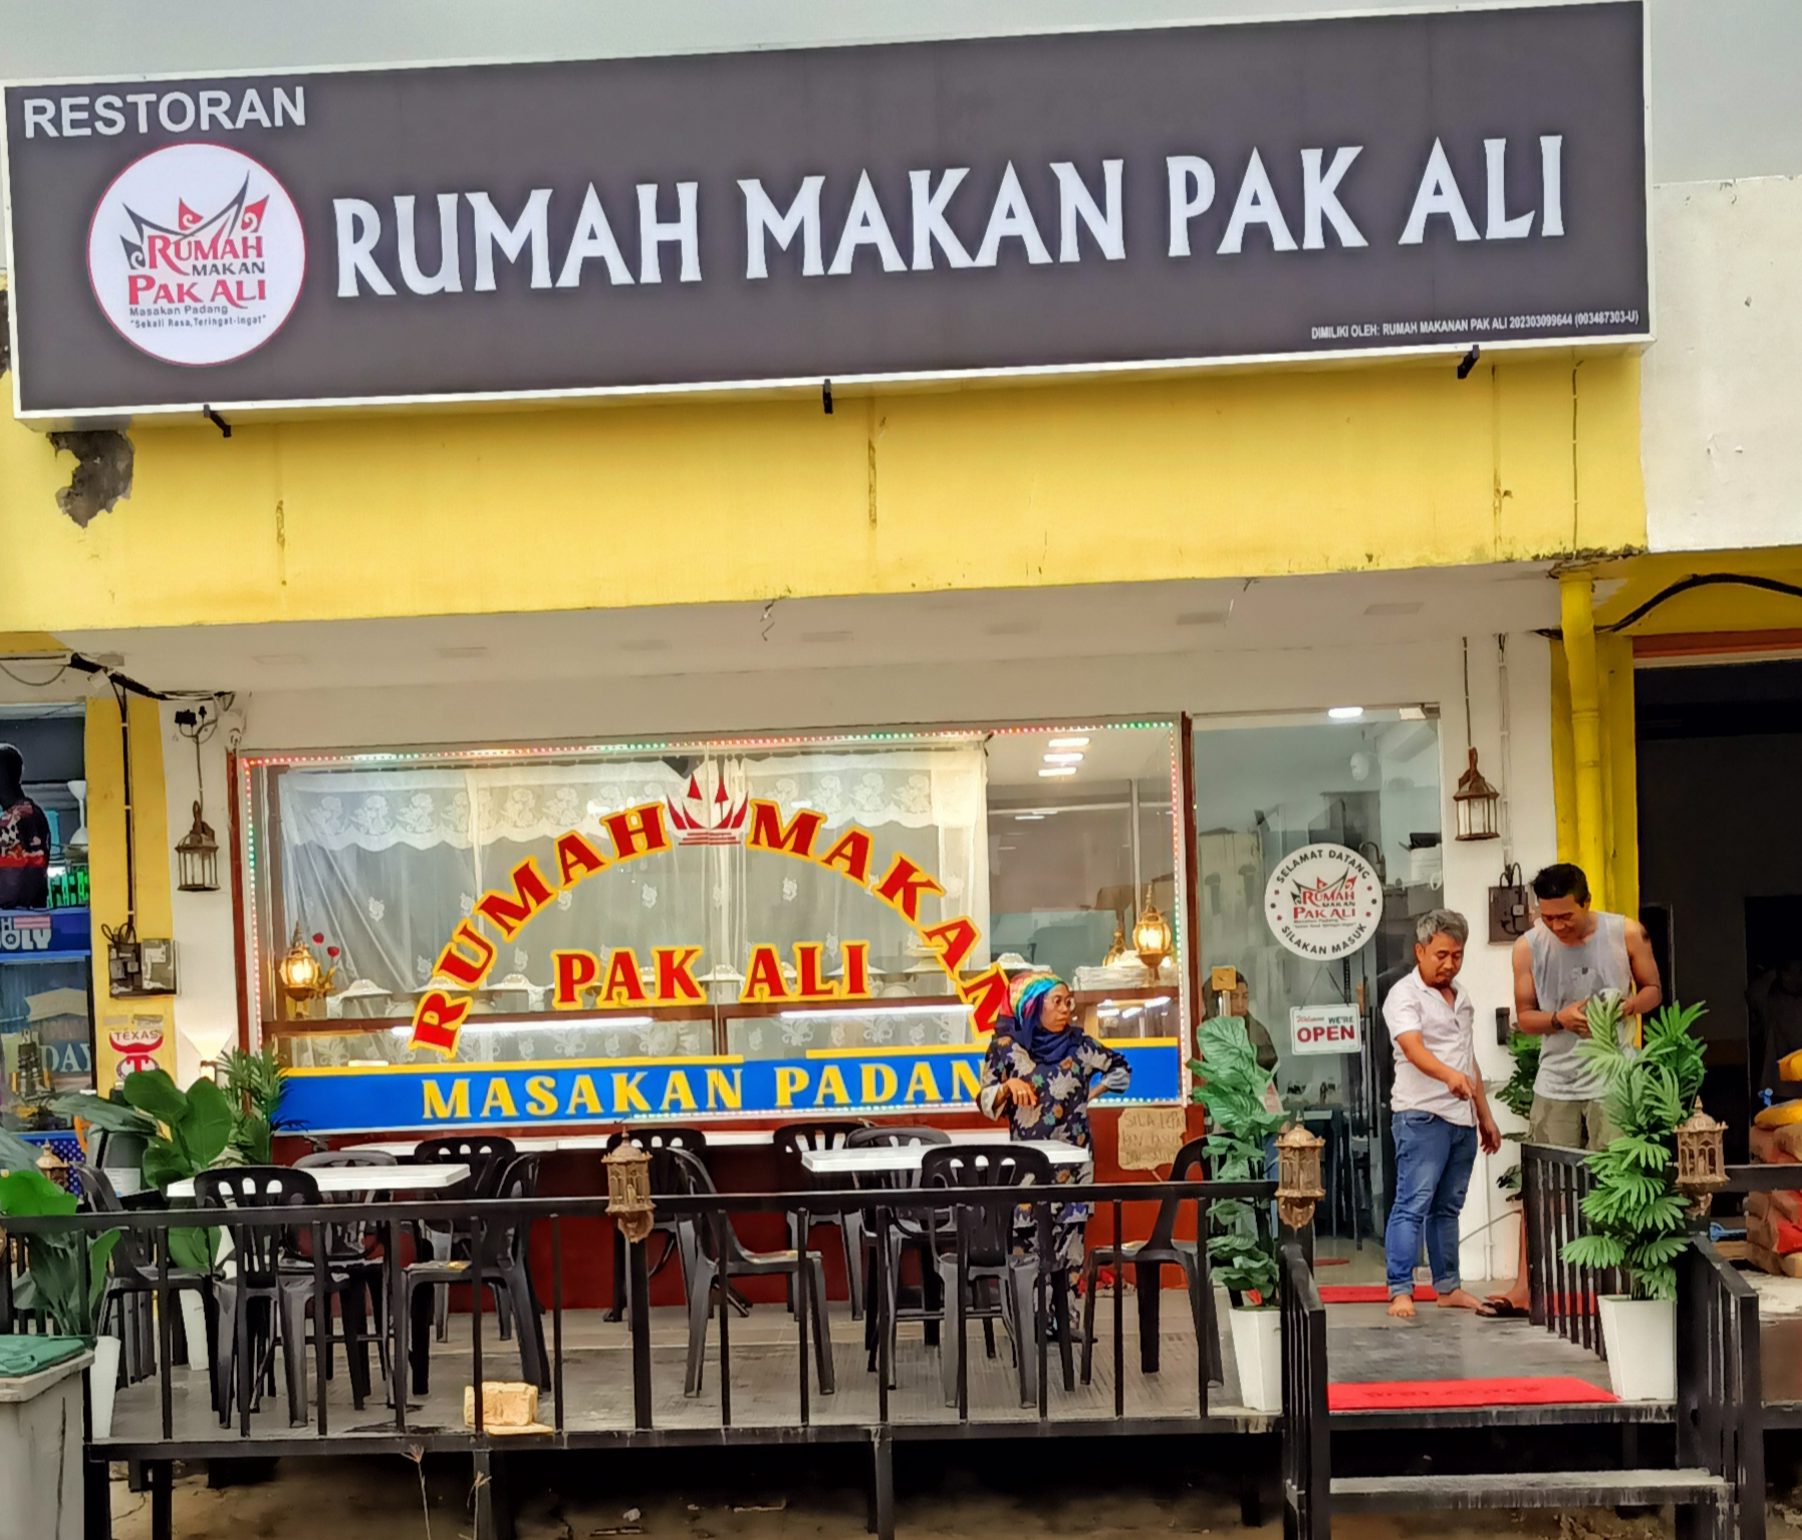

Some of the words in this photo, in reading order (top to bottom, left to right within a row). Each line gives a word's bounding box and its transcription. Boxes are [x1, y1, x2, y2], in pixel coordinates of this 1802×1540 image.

[23, 86, 306, 138] RESTORAN
[332, 180, 702, 298] RUMAH
[736, 159, 1126, 279] MAKAN
[1166, 146, 1369, 256] PAK
[1398, 135, 1565, 246] ALI
[147, 233, 263, 276] RUMAH
[192, 261, 266, 276] MAKAN
[128, 274, 203, 305] PAK
[210, 279, 267, 309] ALI
[130, 307, 181, 317] Masakan
[184, 304, 229, 316] Padang
[1311, 325, 1349, 340] DIMILIKI
[1351, 323, 1380, 337] OLEH:
[1383, 321, 1418, 336] RUMAH
[1420, 318, 1469, 333] MAKANAN
[1471, 317, 1492, 331] PAK
[1492, 316, 1508, 330] ALI
[1277, 849, 1323, 884] SELAMAT
[1328, 849, 1371, 880] DATANG
[1293, 906, 1327, 920] PAK
[1330, 908, 1356, 921] ALI
[1303, 888, 1355, 908] RUMAH
[407, 800, 672, 1059] RUMAH
[746, 797, 1013, 1039] MAKAN
[1281, 925, 1328, 955] SILAKAN
[1331, 923, 1367, 954] MASUK
[552, 943, 706, 1010] PAK
[739, 938, 872, 1004] ALI
[115, 1030, 159, 1041] TEXAS
[1297, 1024, 1355, 1043] OPEN
[421, 1068, 744, 1120] MASAKAN
